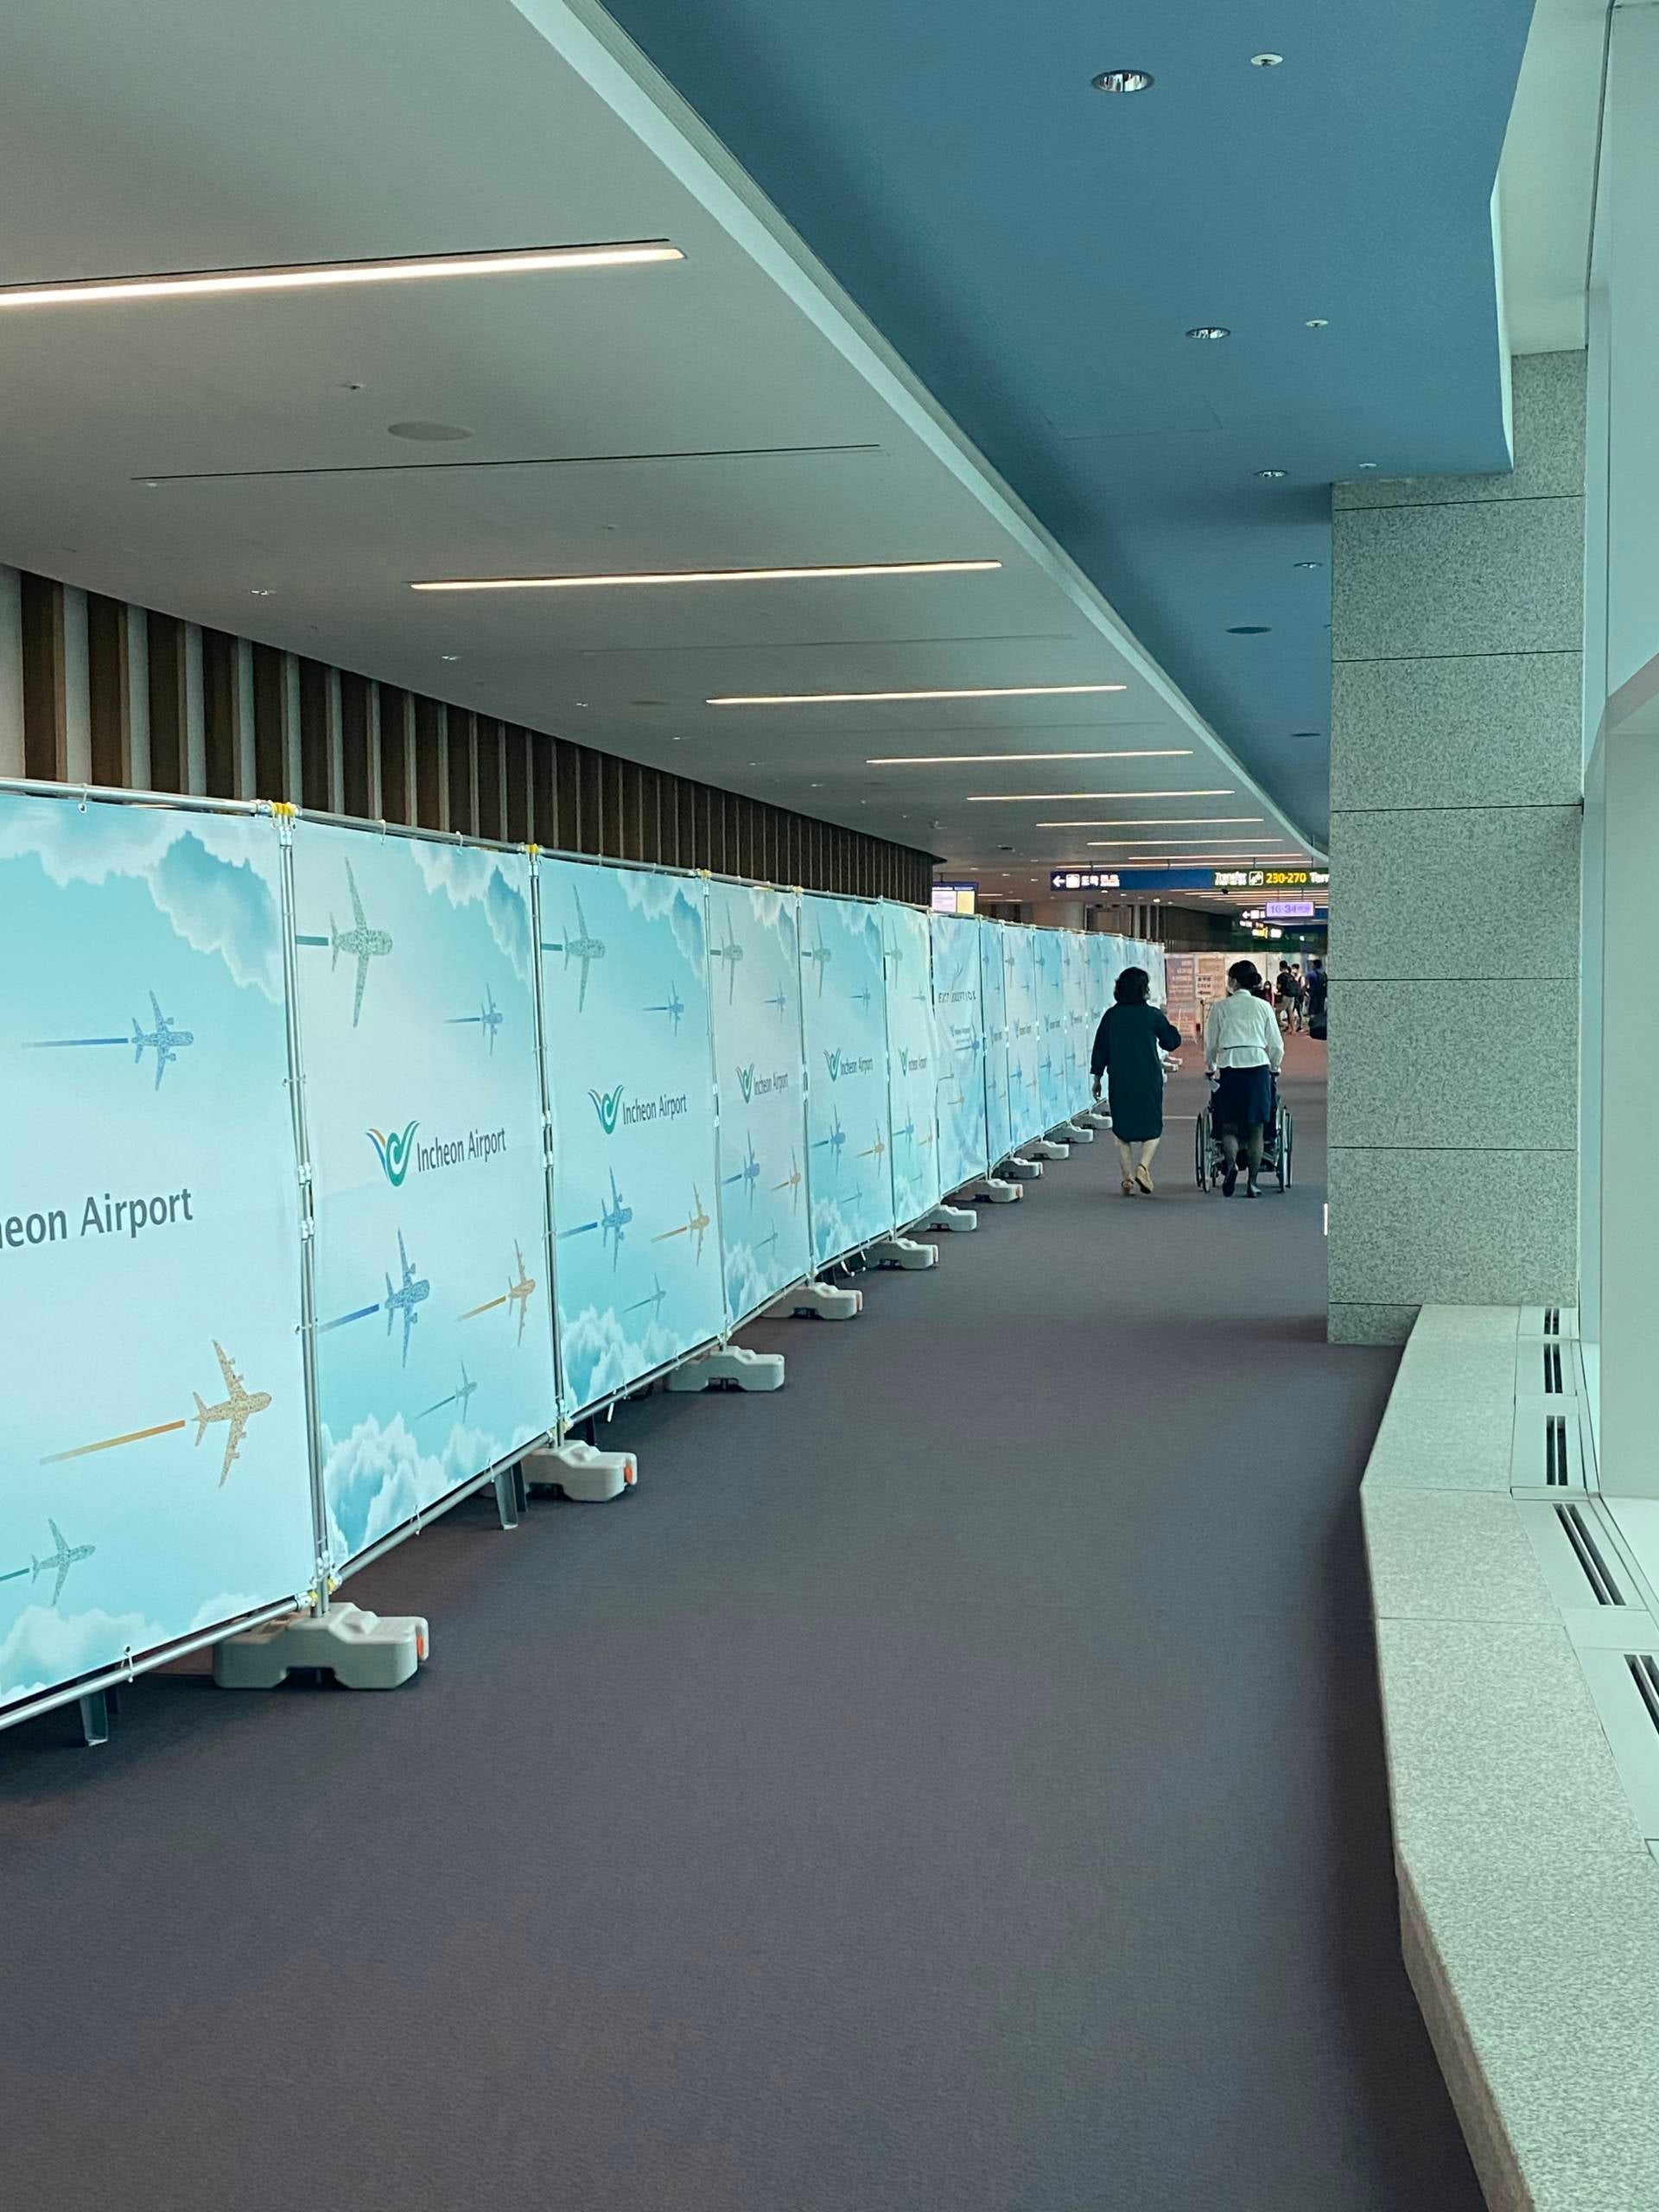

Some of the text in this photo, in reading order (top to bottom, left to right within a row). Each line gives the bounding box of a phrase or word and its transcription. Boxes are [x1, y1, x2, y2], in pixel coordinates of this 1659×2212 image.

[1266, 872, 1306, 884] 230-270
[622, 1093, 687, 1125] Incheon Airport
[416, 1128, 506, 1173] Incheon Airport
[80, 1188, 193, 1238] Airport
